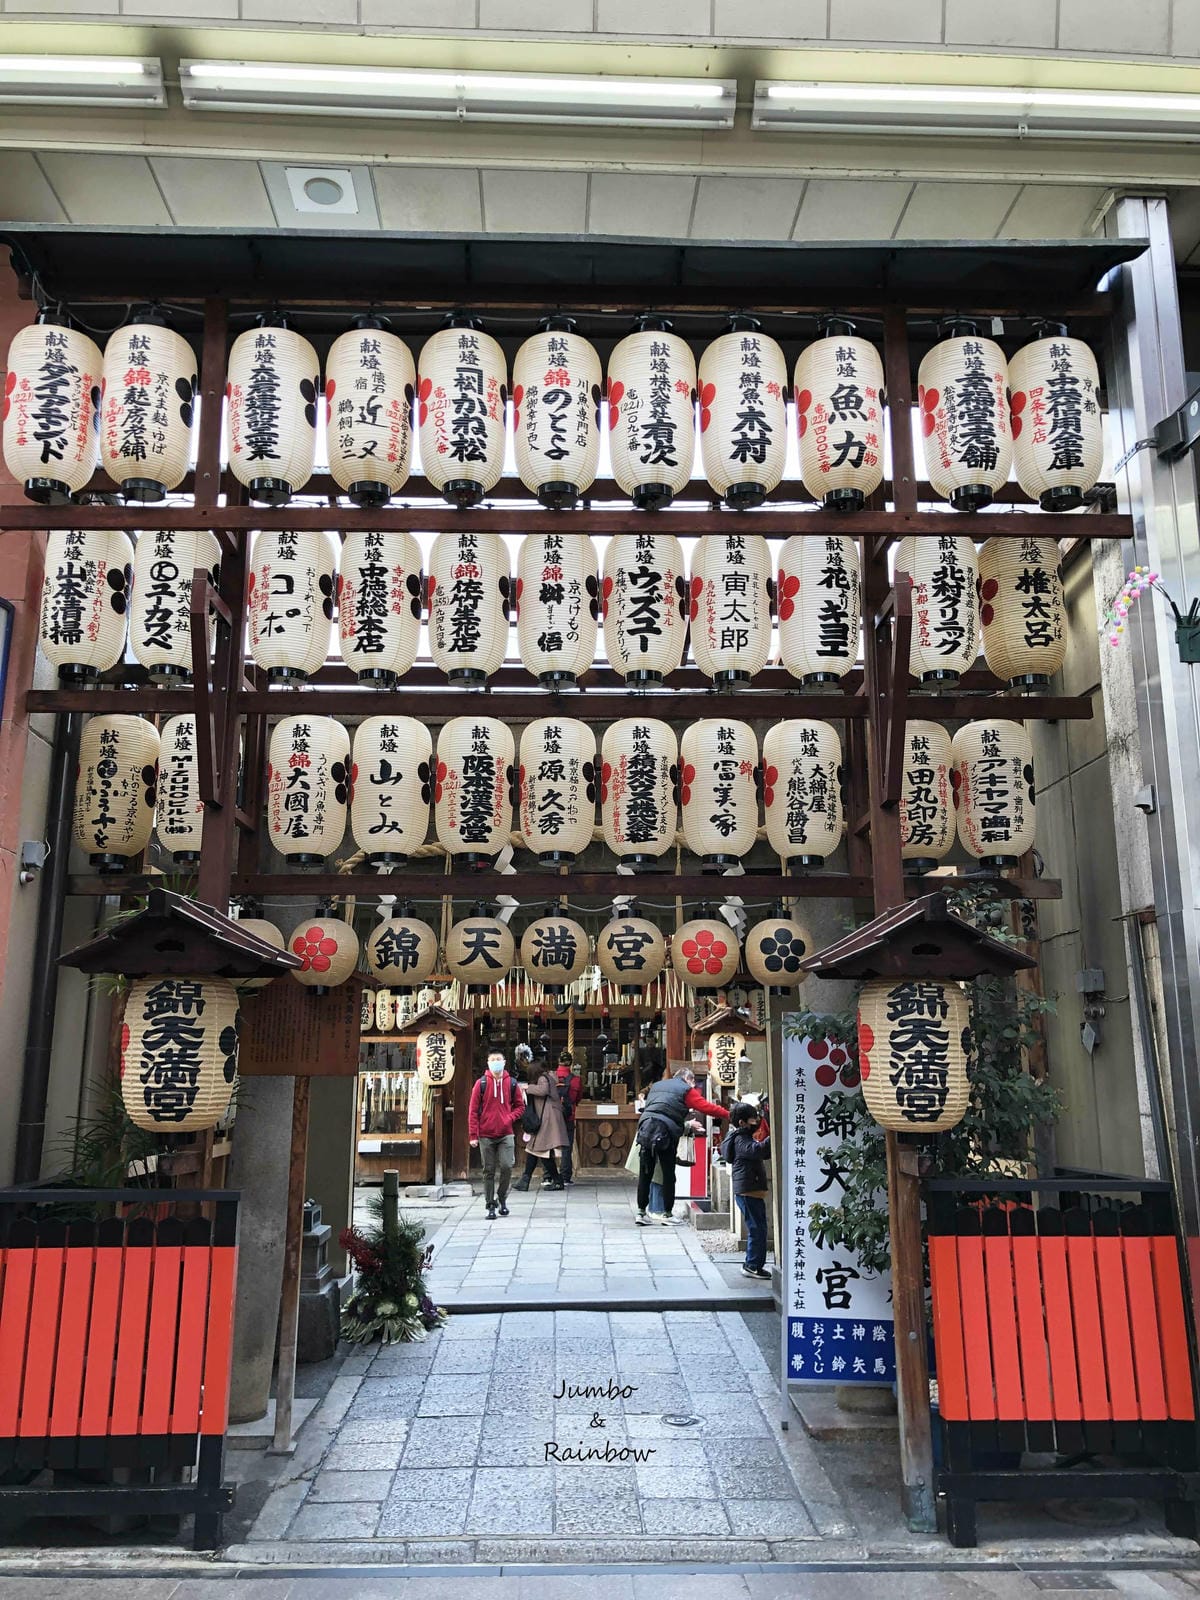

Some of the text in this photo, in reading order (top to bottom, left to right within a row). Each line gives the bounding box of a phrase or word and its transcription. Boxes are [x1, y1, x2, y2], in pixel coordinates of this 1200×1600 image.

[45, 331, 69, 363] 献燈
[128, 334, 151, 367] 献燈
[255, 334, 276, 364] 献燈
[359, 338, 382, 370] 献燈
[458, 334, 480, 367] 献燈
[547, 337, 569, 368] 献燈
[650, 341, 671, 374] 献燈
[740, 337, 762, 369] 献燈
[835, 345, 858, 378] 献燈
[962, 341, 986, 372] 献燈
[1049, 343, 1073, 373] 献燈
[122, 367, 152, 387] 錦
[487, 376, 500, 422] 京野菜
[543, 368, 571, 388] 錦
[31, 362, 79, 464] ダイアモンド
[354, 394, 390, 462] 近又
[448, 392, 488, 463] かね松
[728, 371, 774, 464] 鮮魚 木村
[827, 382, 870, 470] 魚力
[954, 370, 1001, 472] 幸福堂老舗
[1028, 386, 1048, 446] 四条支店
[1045, 372, 1086, 472] 中央信用金庫
[639, 419, 679, 468] 有次
[364, 532, 385, 562] 献燈
[458, 534, 478, 564] 献燈
[543, 535, 564, 565] 献燈
[636, 535, 656, 565] 献燈
[726, 535, 746, 565] 献燈
[825, 537, 845, 567] 献燈
[49, 561, 89, 646] 山本清掃
[353, 563, 389, 654] 中徳総本店
[566, 579, 582, 642] 京つけもの
[626, 565, 663, 653] ウィズユー
[720, 570, 751, 653] 寅太郎
[931, 565, 965, 656] 北村クリニック
[100, 729, 120, 760] 献燈
[175, 722, 194, 751] 献燈
[292, 723, 312, 753] 献燈
[380, 724, 400, 753] 献燈
[471, 725, 490, 755] 献燈
[543, 726, 562, 754] 献燈
[632, 725, 652, 755] 献燈
[717, 726, 736, 756] 献燈
[800, 728, 820, 758] 献燈
[911, 736, 931, 766] 献燈
[981, 730, 1002, 758] 献燈
[288, 752, 312, 768] 錦
[368, 758, 404, 834] 山とみ
[459, 754, 496, 844] 阪本漢方堂
[625, 753, 659, 843] 積水ハウス株式会社
[709, 759, 739, 838] 富美家
[905, 768, 939, 846] 田丸印房
[978, 758, 1012, 842] アキヤマ歯科
[374, 925, 654, 973] 錦 天 満 宮
[139, 979, 207, 1122] 錦天満宮
[426, 1031, 448, 1082] 錦天満宮
[716, 1034, 738, 1084] 錦天満宮
[886, 981, 951, 1122] 錦天満宮
[791, 1322, 806, 1372] 腹帯
[812, 1323, 825, 1373] おみくじ
[831, 1324, 847, 1373] 土鈴
[852, 1324, 867, 1374] 神矢
[872, 1325, 887, 1375] 絵馬
